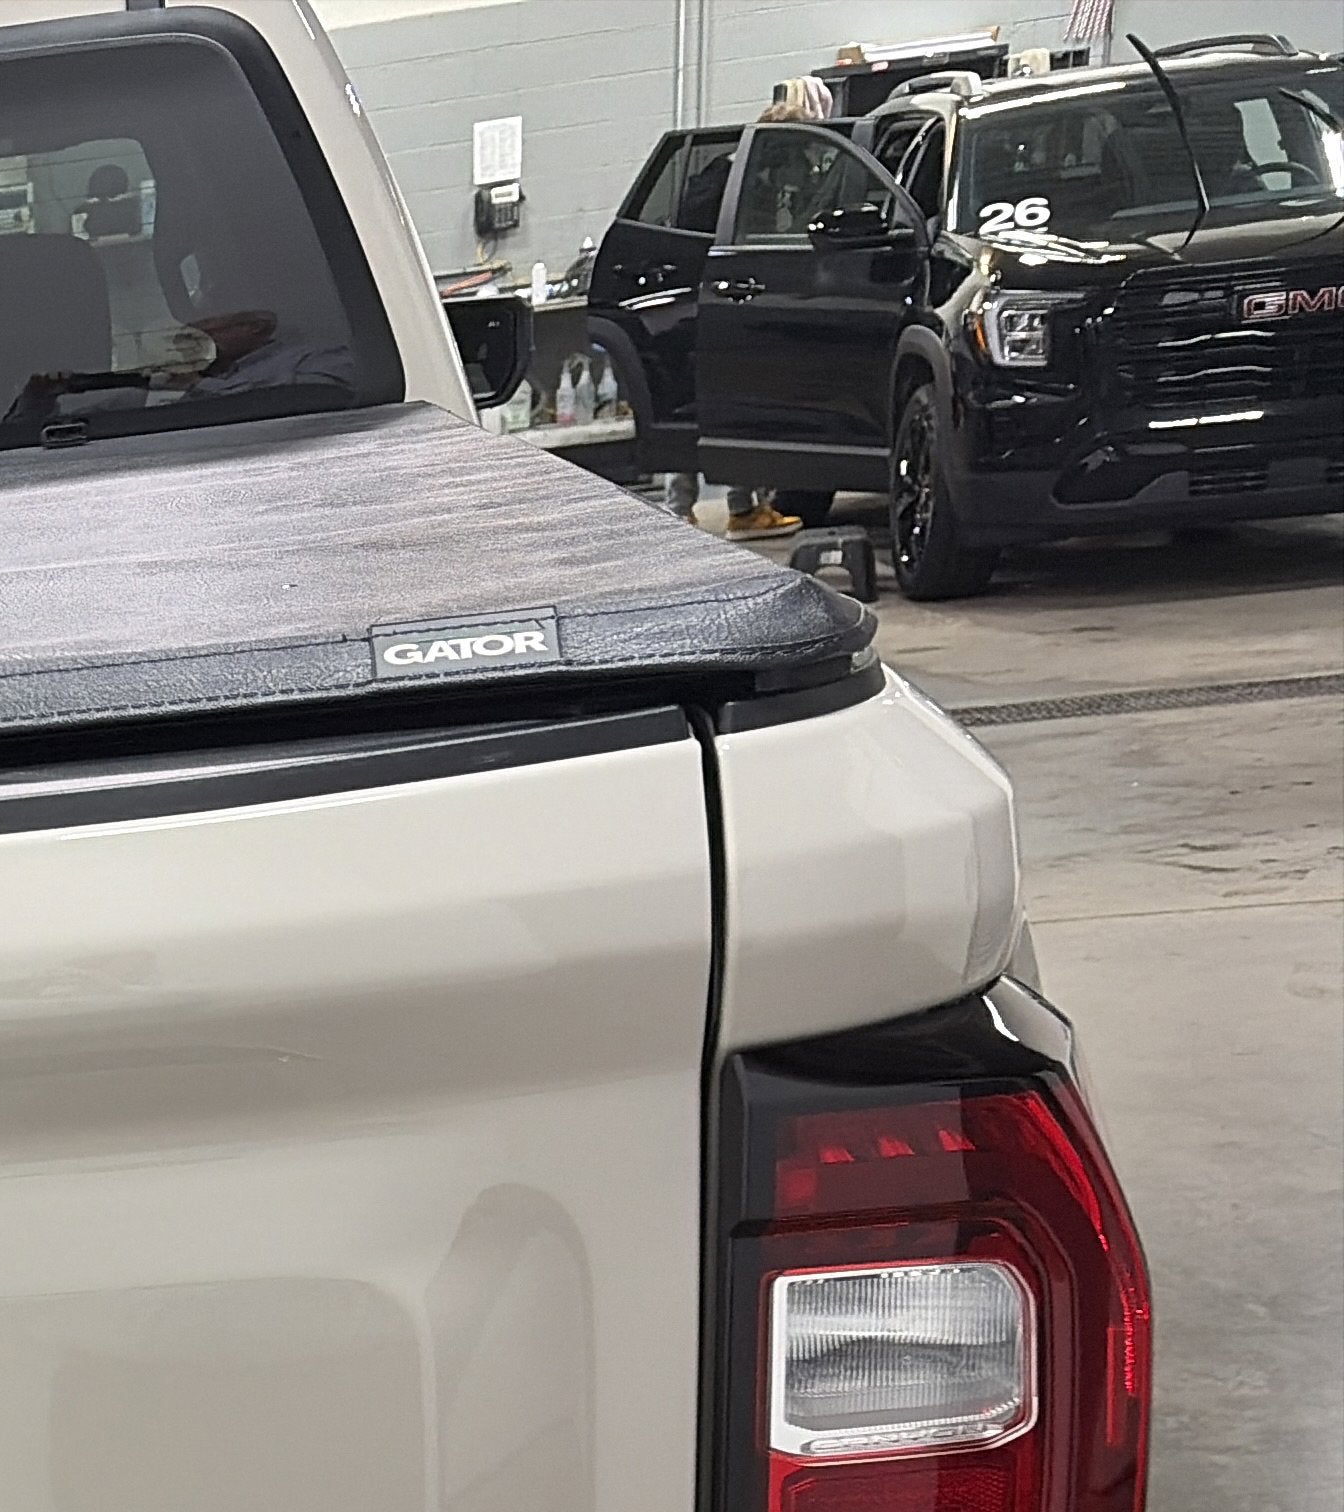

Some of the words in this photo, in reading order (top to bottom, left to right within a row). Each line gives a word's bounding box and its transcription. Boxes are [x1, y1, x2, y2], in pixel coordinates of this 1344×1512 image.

[979, 197, 1050, 235] 26
[1243, 286, 1344, 318] GM
[383, 631, 548, 665] GATOR
